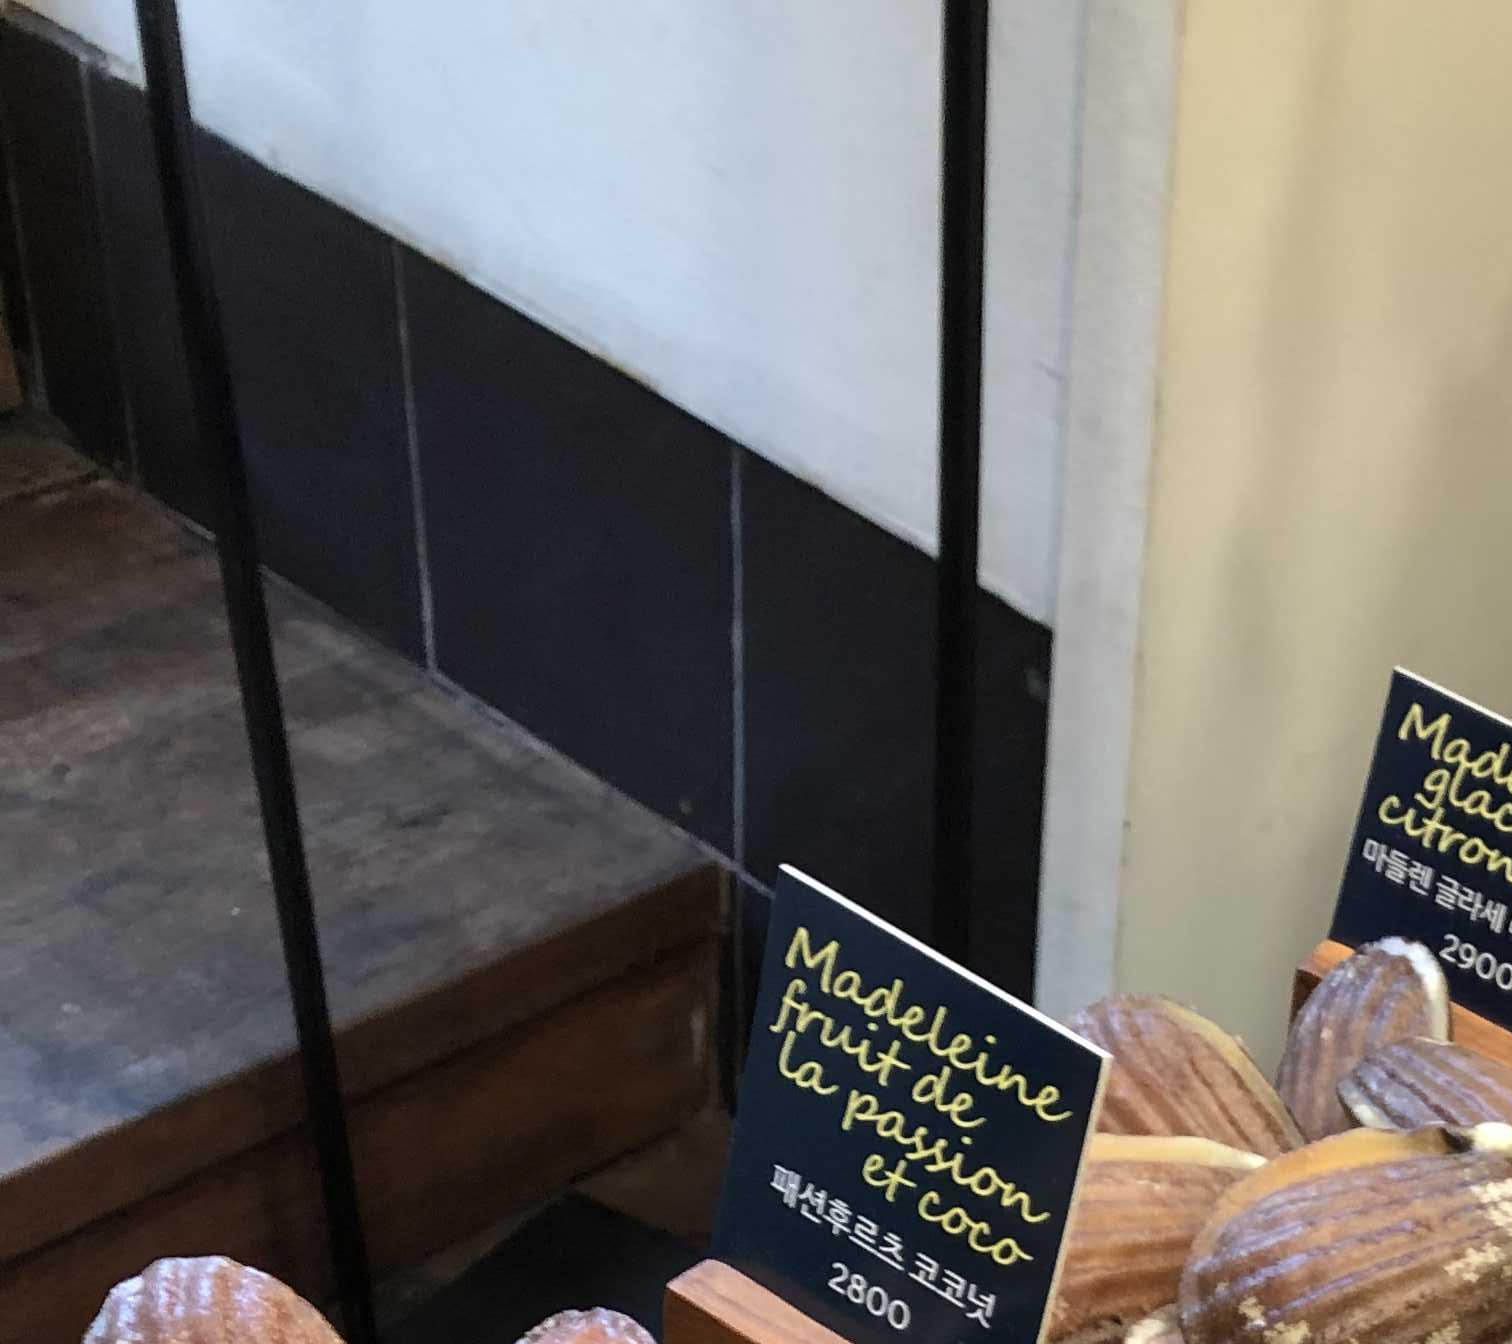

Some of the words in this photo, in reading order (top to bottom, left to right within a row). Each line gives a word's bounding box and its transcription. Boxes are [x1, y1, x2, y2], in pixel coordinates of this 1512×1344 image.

[1362, 838, 1434, 896] 마들렌
[1434, 872, 1505, 934] 글라세
[769, 979, 912, 1086] fruit
[911, 1063, 986, 1128] de
[784, 926, 1073, 1123] Madeleine
[778, 1031, 839, 1096] la
[841, 1088, 1051, 1225] passion
[770, 1164, 904, 1271] 패션후르츠
[908, 1252, 997, 1329] 코코넛
[862, 1151, 916, 1202] et
[917, 1189, 1034, 1266] coco
[827, 1261, 912, 1331] 2800
